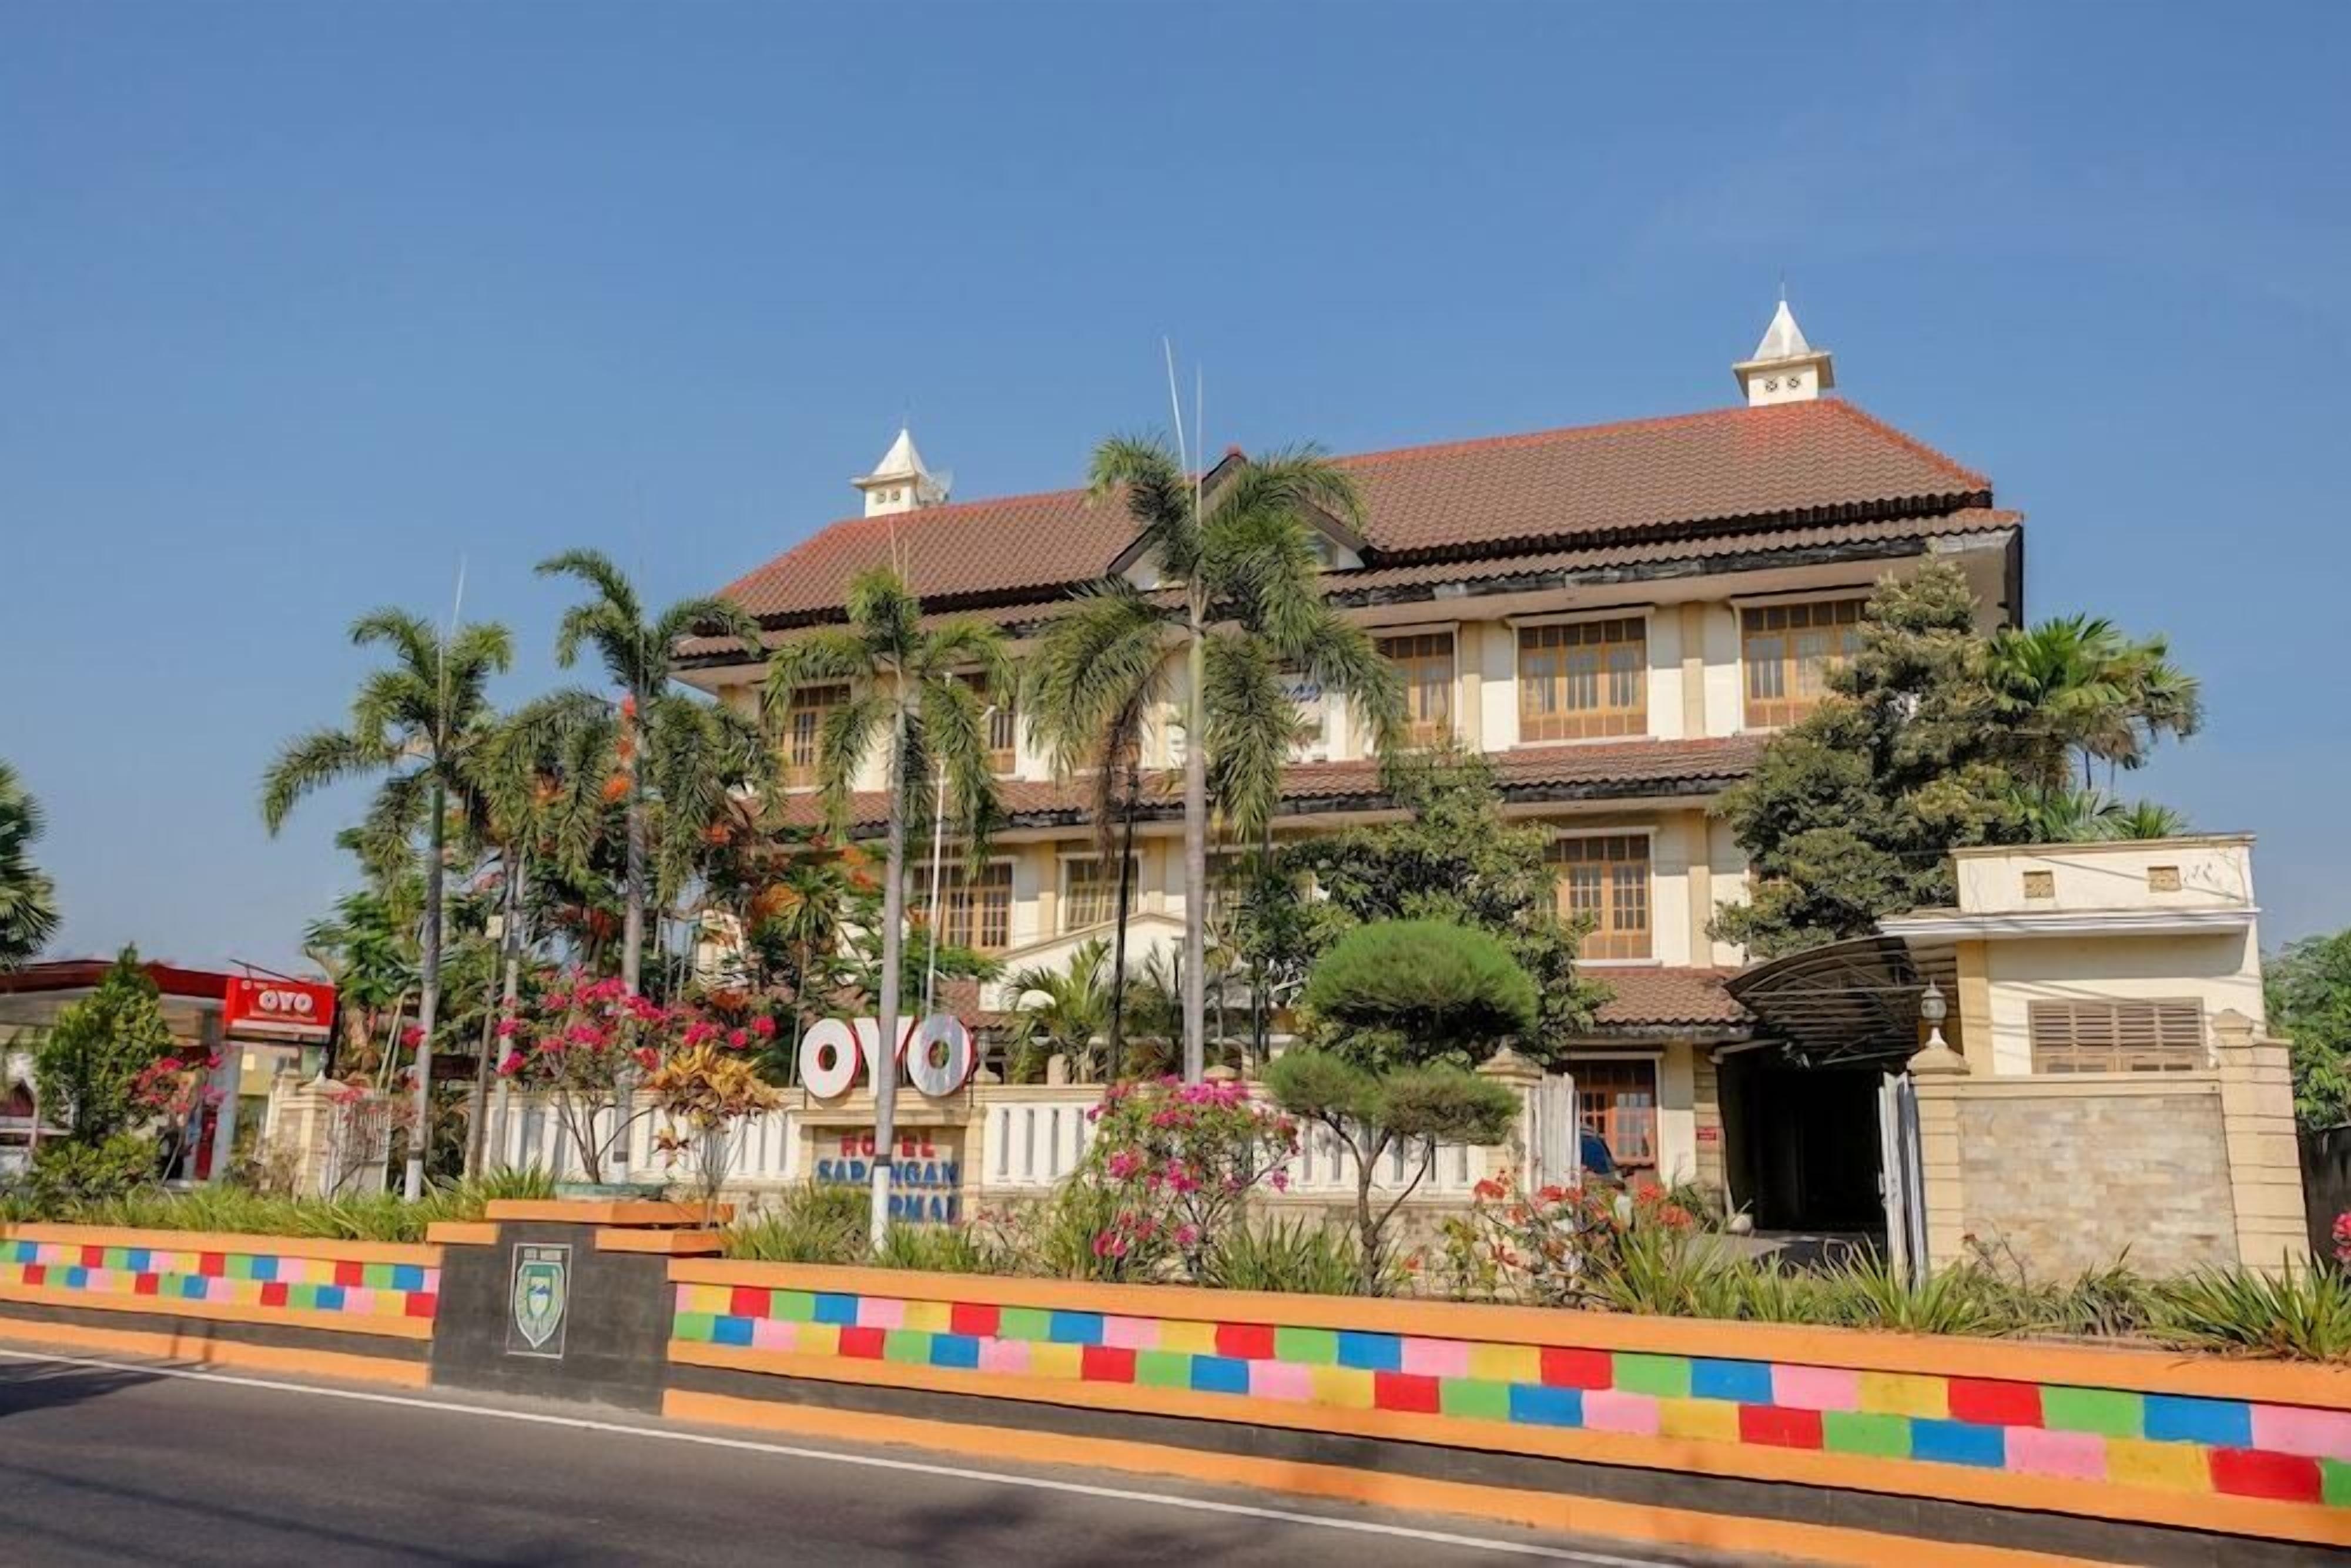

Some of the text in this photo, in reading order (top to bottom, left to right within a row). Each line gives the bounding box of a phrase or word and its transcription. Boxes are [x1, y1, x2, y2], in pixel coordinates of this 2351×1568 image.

[259, 990, 313, 1014] OYO
[799, 1015, 974, 1098] OYO
[841, 1136, 936, 1157] HOEL
